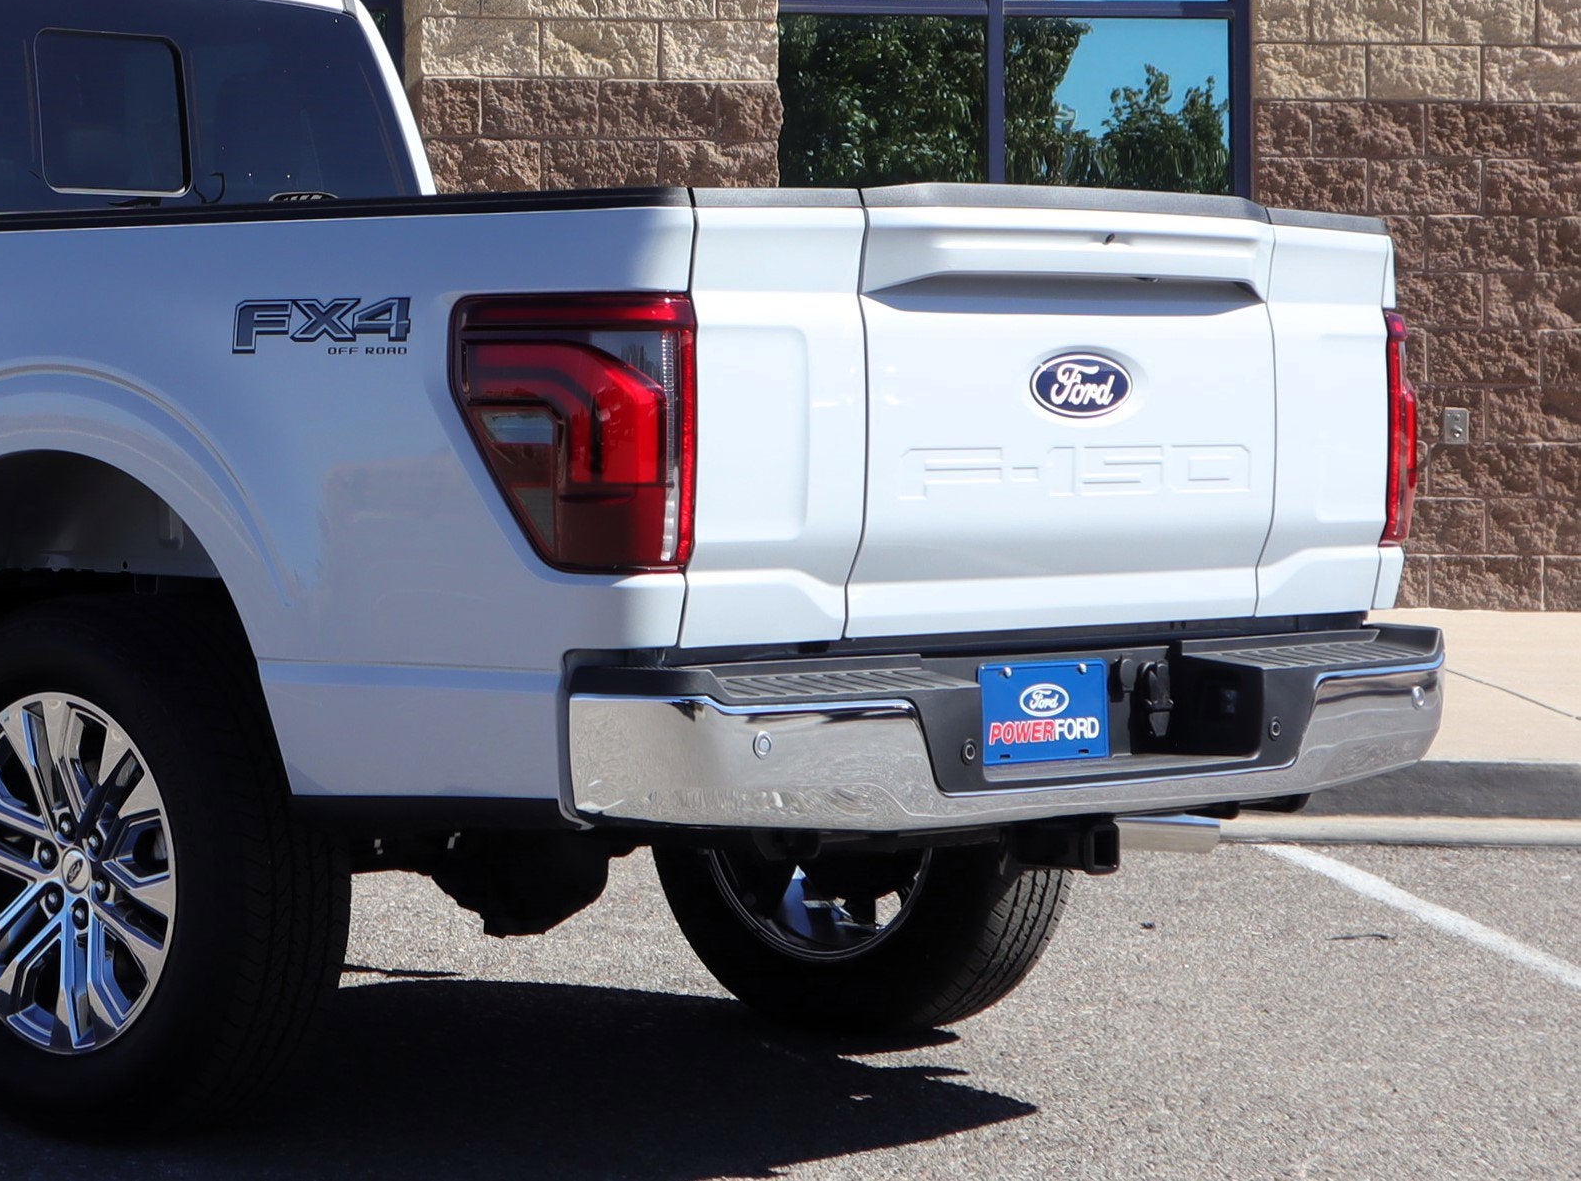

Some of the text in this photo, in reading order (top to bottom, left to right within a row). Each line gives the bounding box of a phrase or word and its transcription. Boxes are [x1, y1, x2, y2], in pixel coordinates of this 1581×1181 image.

[232, 297, 411, 354] FX4
[328, 347, 408, 355] OFF ROAD
[1050, 362, 1115, 406] Ford
[897, 444, 1251, 500] F-150
[1028, 689, 1059, 710] Ford
